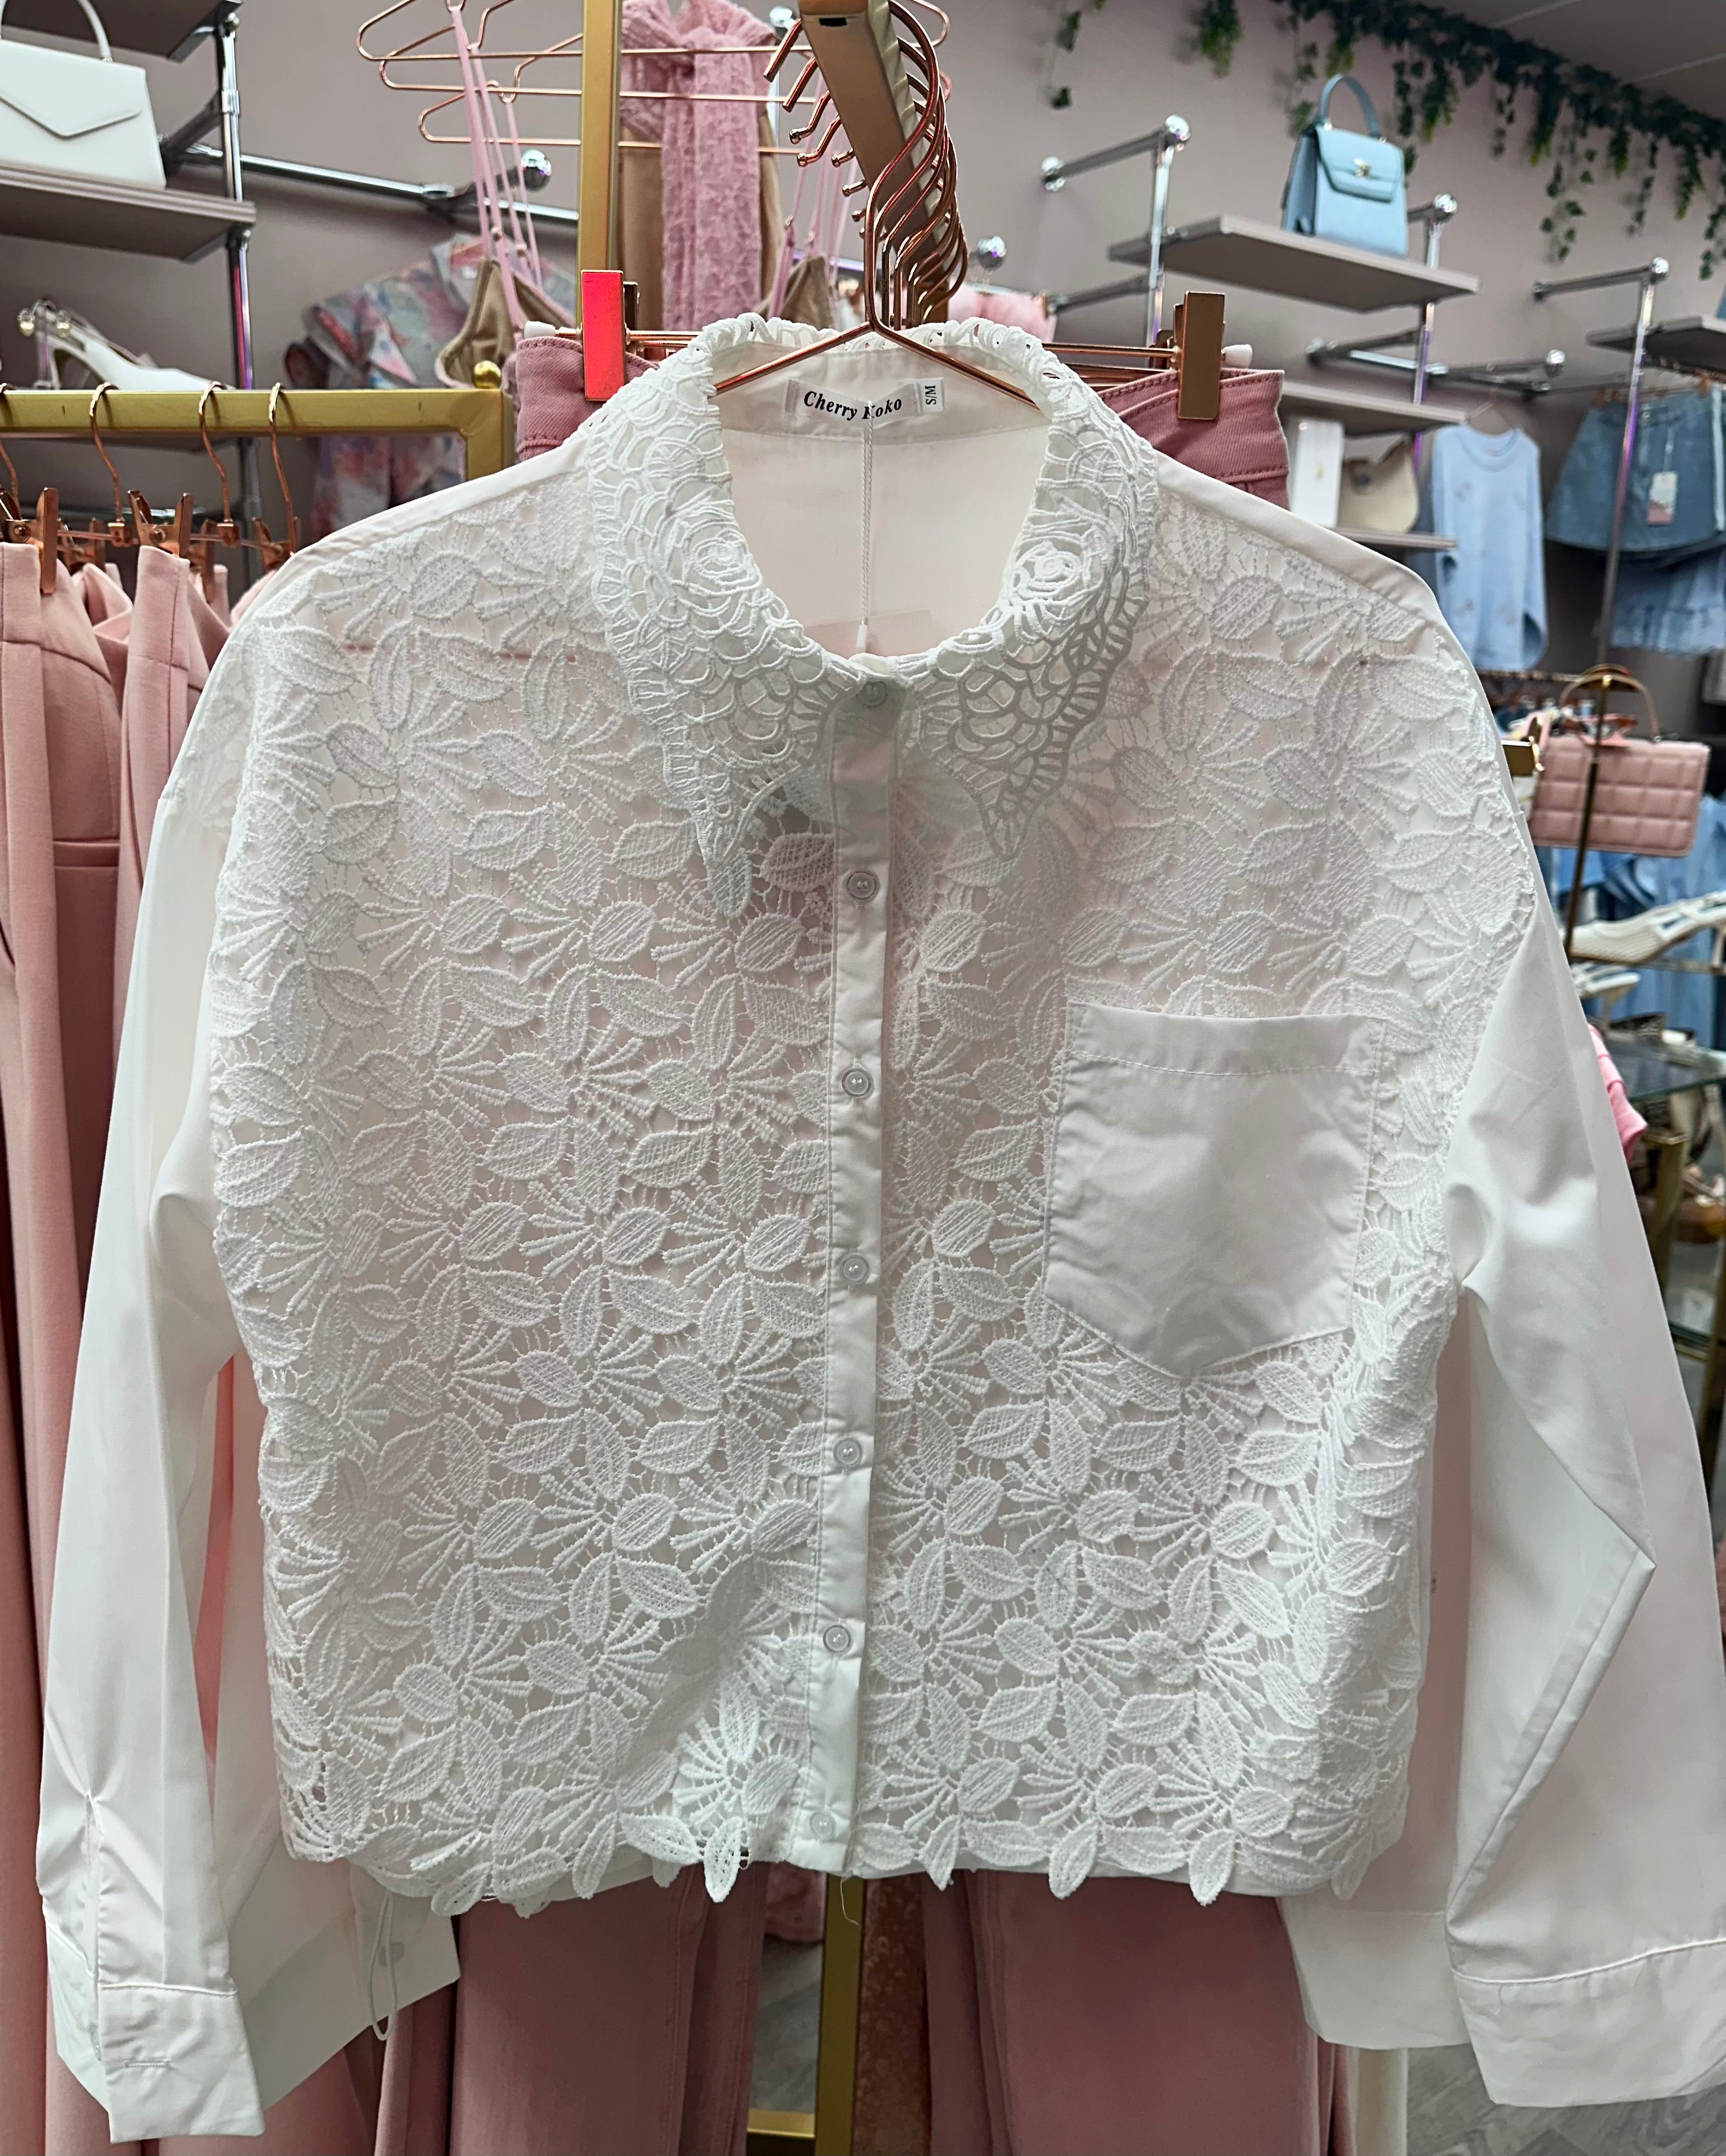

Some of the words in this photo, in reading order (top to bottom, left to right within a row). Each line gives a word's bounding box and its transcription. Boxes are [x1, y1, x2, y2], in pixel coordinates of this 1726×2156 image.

[803, 391, 858, 421] Cherry
[862, 399, 902, 419] Koko
[924, 385, 936, 405] S/M
